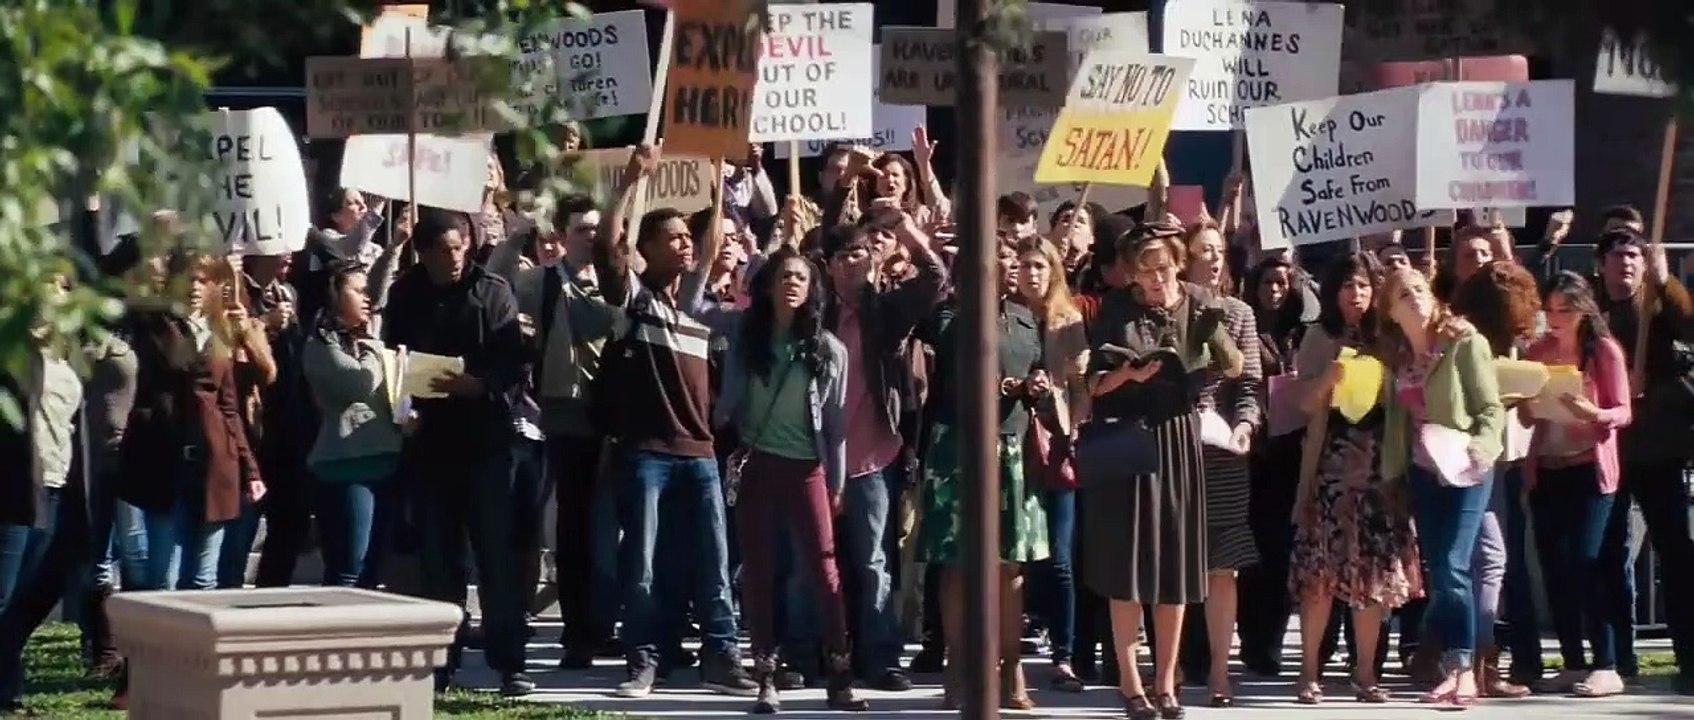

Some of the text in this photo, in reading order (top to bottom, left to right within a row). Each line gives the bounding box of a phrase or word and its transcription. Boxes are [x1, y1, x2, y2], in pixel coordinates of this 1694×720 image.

[802, 11, 854, 30] THE
[1212, 8, 1271, 27] LENA
[768, 35, 832, 59] EVIL
[1180, 29, 1301, 54] DUCHANNES
[570, 51, 601, 69] GO!
[1222, 56, 1269, 77] WILL
[763, 62, 837, 83] UT OF
[1080, 64, 1176, 106] SAY NO TO
[1237, 80, 1282, 101] OUR
[765, 88, 817, 108] OUR
[1516, 89, 1531, 107] A
[753, 112, 847, 134] CHOOL!
[1292, 107, 1385, 142] Keep Our
[217, 134, 272, 161] PEL
[1057, 127, 1154, 171] SATAN!
[1293, 143, 1374, 173] Children
[217, 173, 252, 200] HE
[1301, 175, 1390, 205] Safe From
[213, 204, 282, 243] VIL!
[1278, 199, 1436, 238] RAVENWOOD
